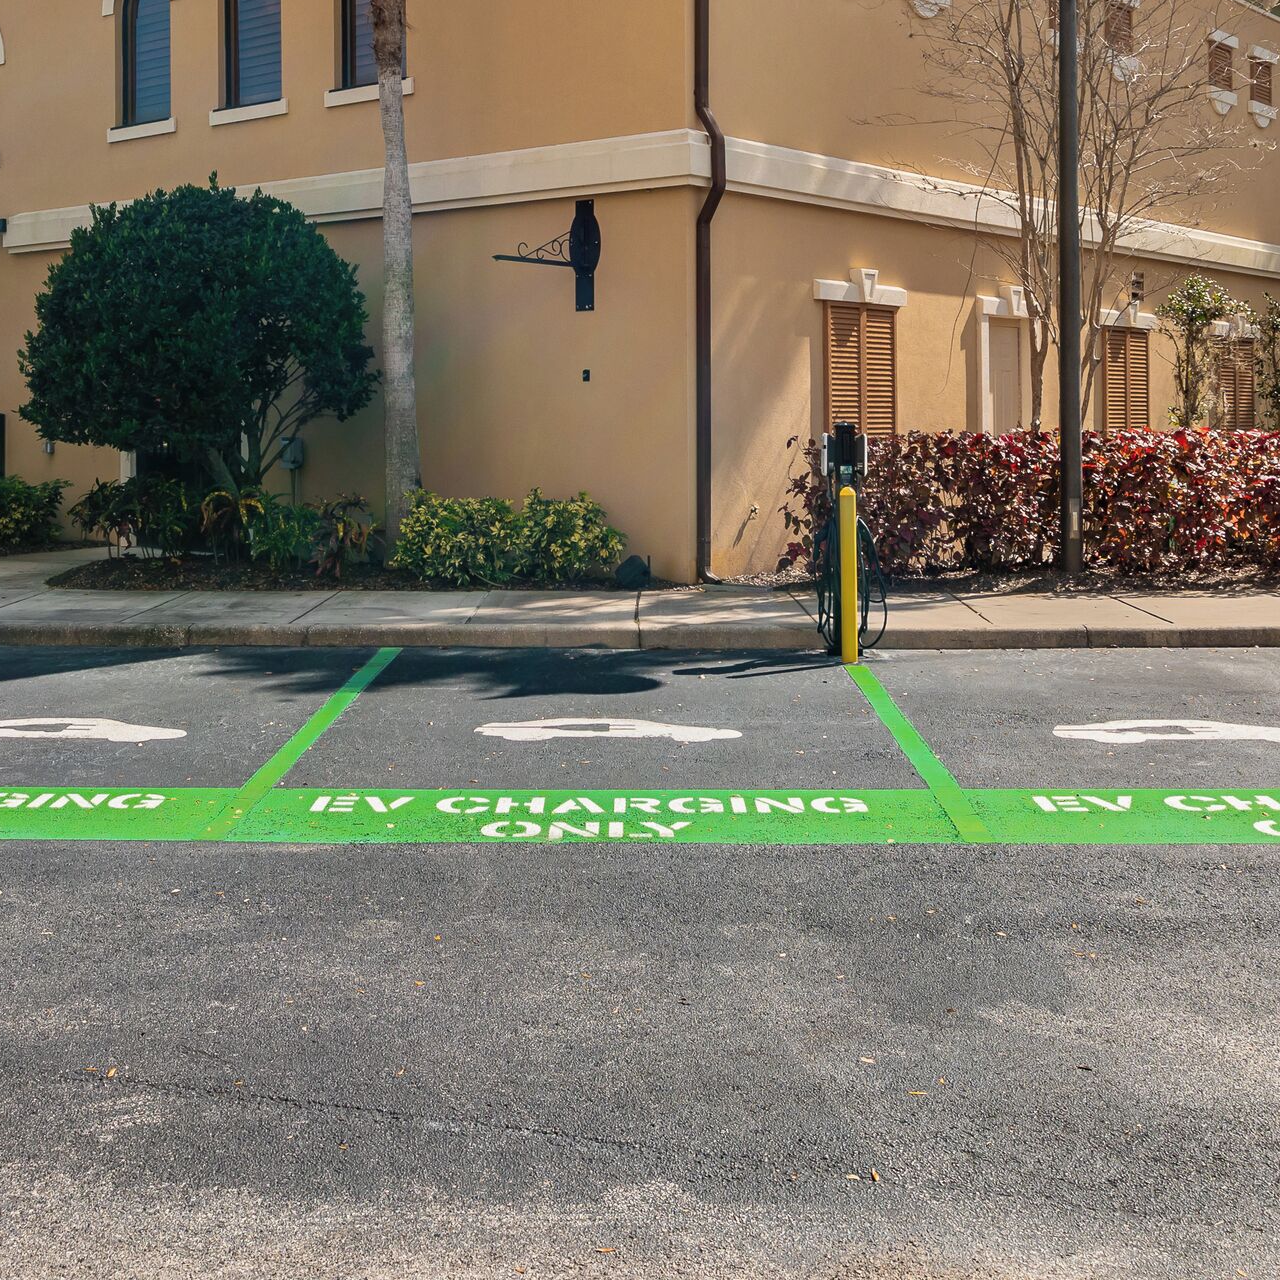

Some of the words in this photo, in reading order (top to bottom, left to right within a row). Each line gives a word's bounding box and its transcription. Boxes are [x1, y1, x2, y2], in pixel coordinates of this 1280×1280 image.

[310, 794, 414, 812] EV
[436, 796, 868, 814] CHARGING
[1032, 796, 1132, 812] EV
[481, 821, 691, 838] ONLY
